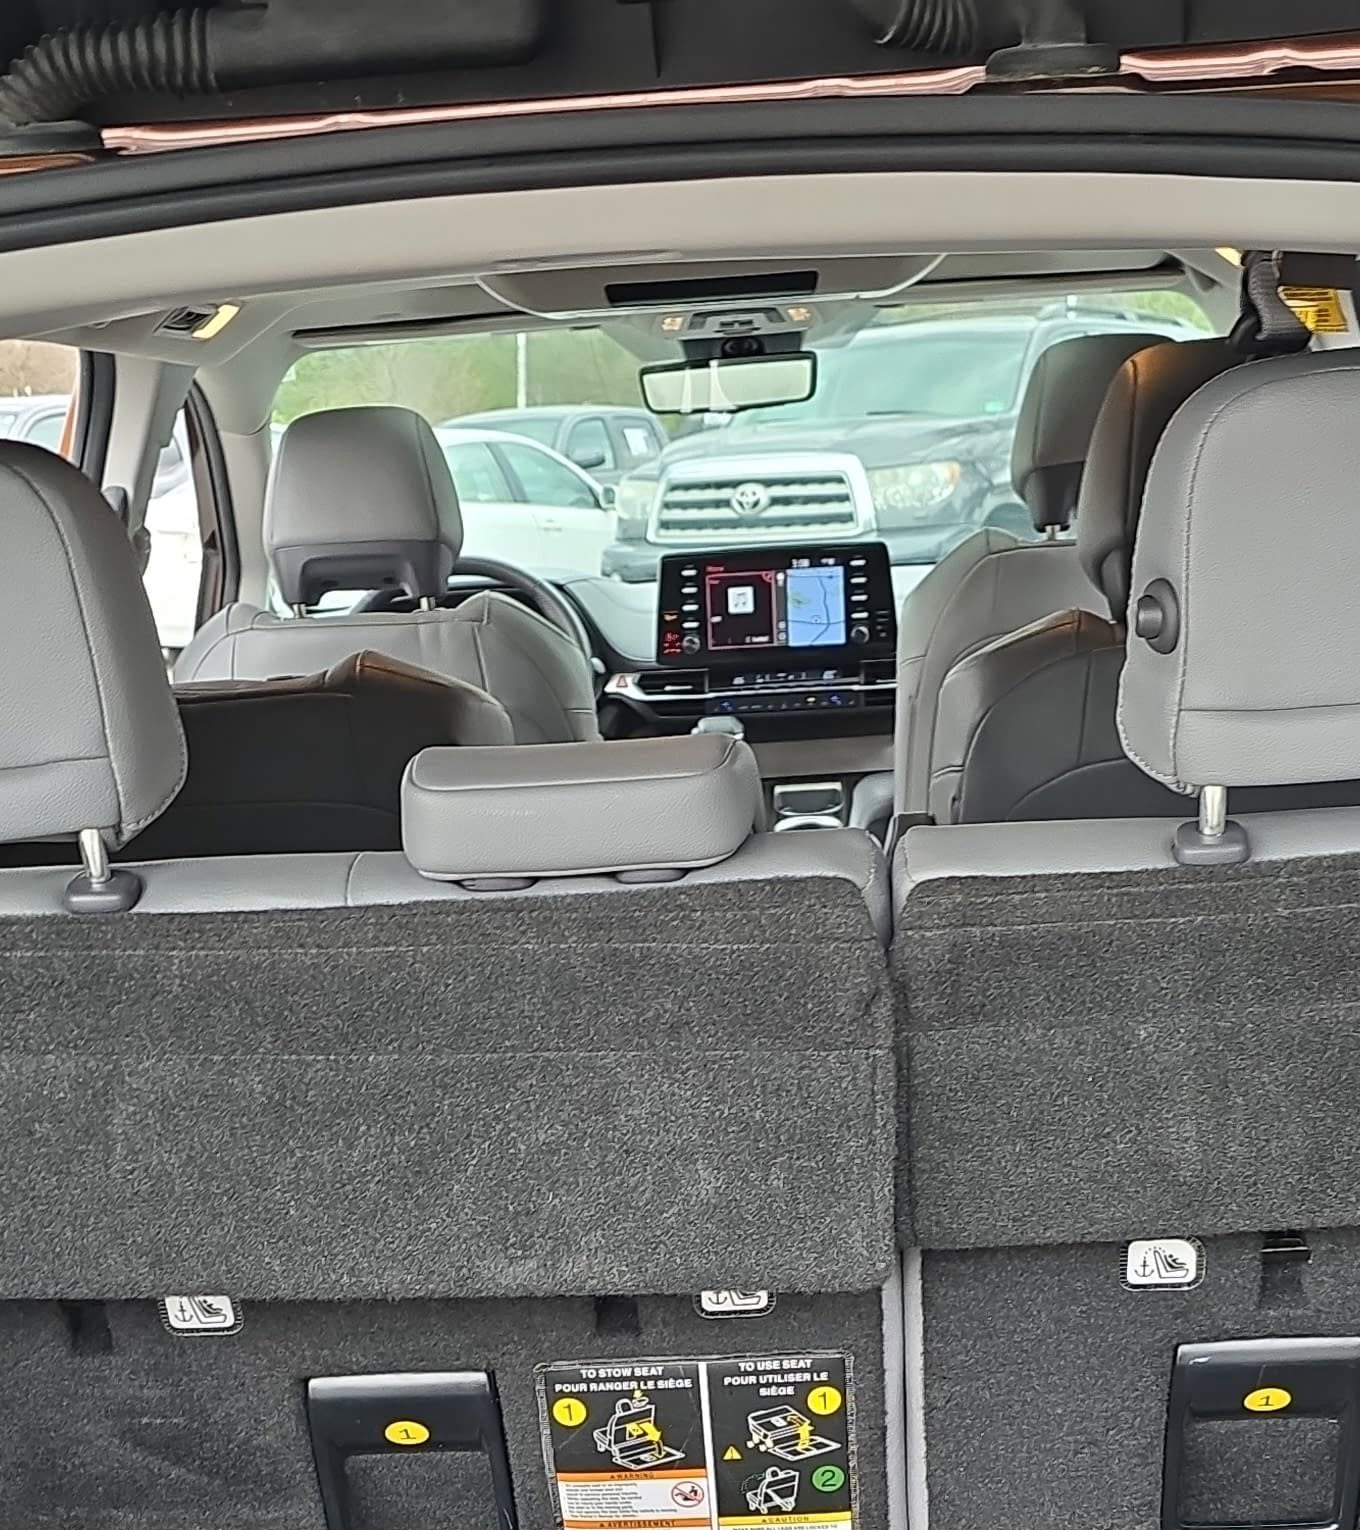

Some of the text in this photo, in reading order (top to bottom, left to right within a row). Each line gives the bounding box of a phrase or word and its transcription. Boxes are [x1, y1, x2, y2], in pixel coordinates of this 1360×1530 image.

[580, 1366, 664, 1379] TO STOW SEAT
[738, 1359, 813, 1372] TO USE SEAT
[554, 1378, 693, 1393] POUR RANGER LE SIÈGE
[723, 1371, 829, 1386] POUR UTILISER LE
[758, 1385, 795, 1396] SIÈGE
[818, 1392, 827, 1410] 1
[1258, 1396, 1275, 1407] 1
[563, 1404, 573, 1421] 1
[398, 1428, 416, 1440] 1
[820, 1470, 837, 1488] 2
